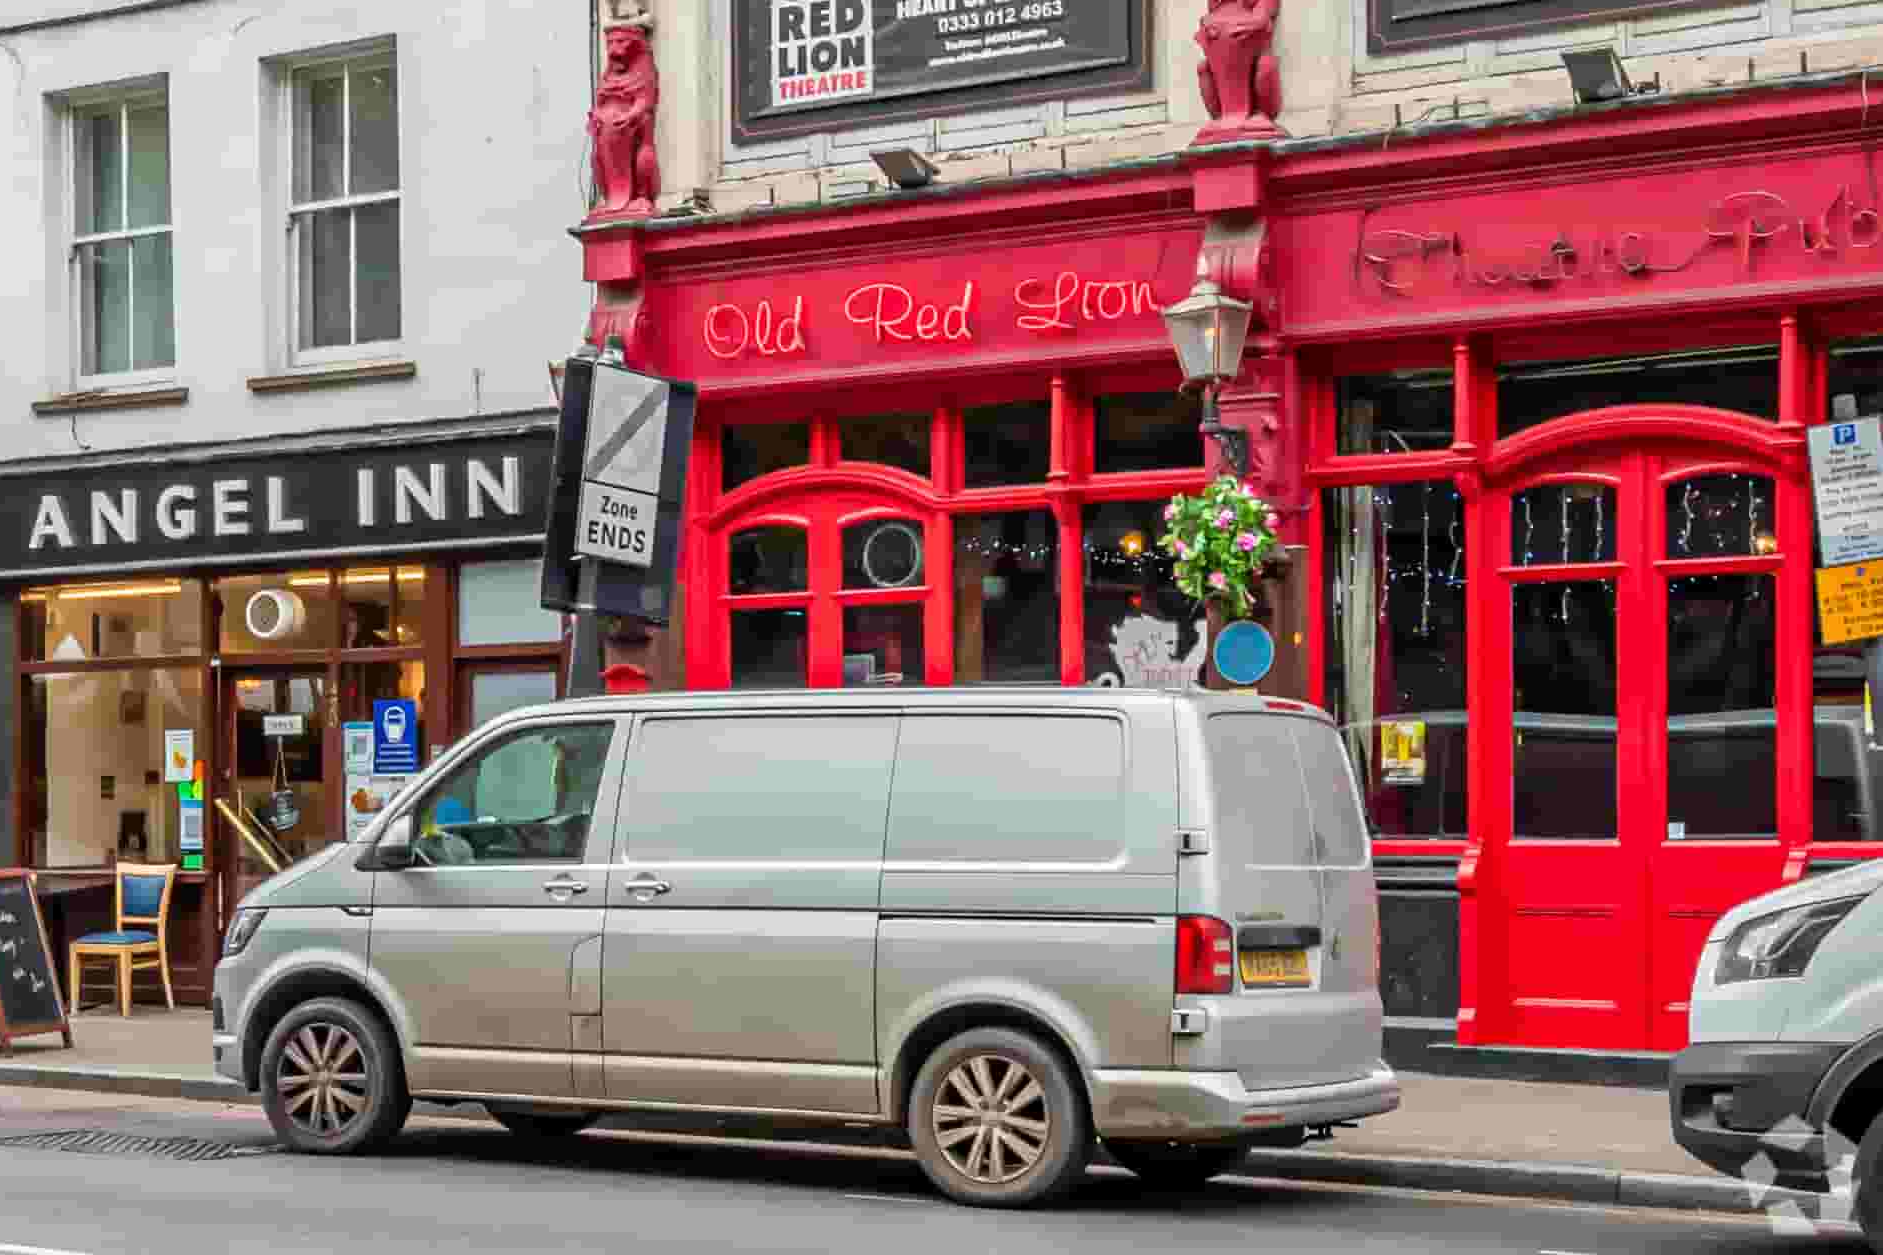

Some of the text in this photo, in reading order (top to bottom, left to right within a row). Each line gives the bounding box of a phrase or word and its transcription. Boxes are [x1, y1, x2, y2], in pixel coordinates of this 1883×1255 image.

[938, 0, 1063, 33] 0333 012 4963
[778, 35, 866, 77] LION
[778, 71, 867, 101] THEATRE
[703, 272, 1159, 359] Old Red Lion
[28, 455, 523, 549] ANGEL INN
[600, 496, 638, 521] Zone
[588, 520, 646, 553] ENDS
